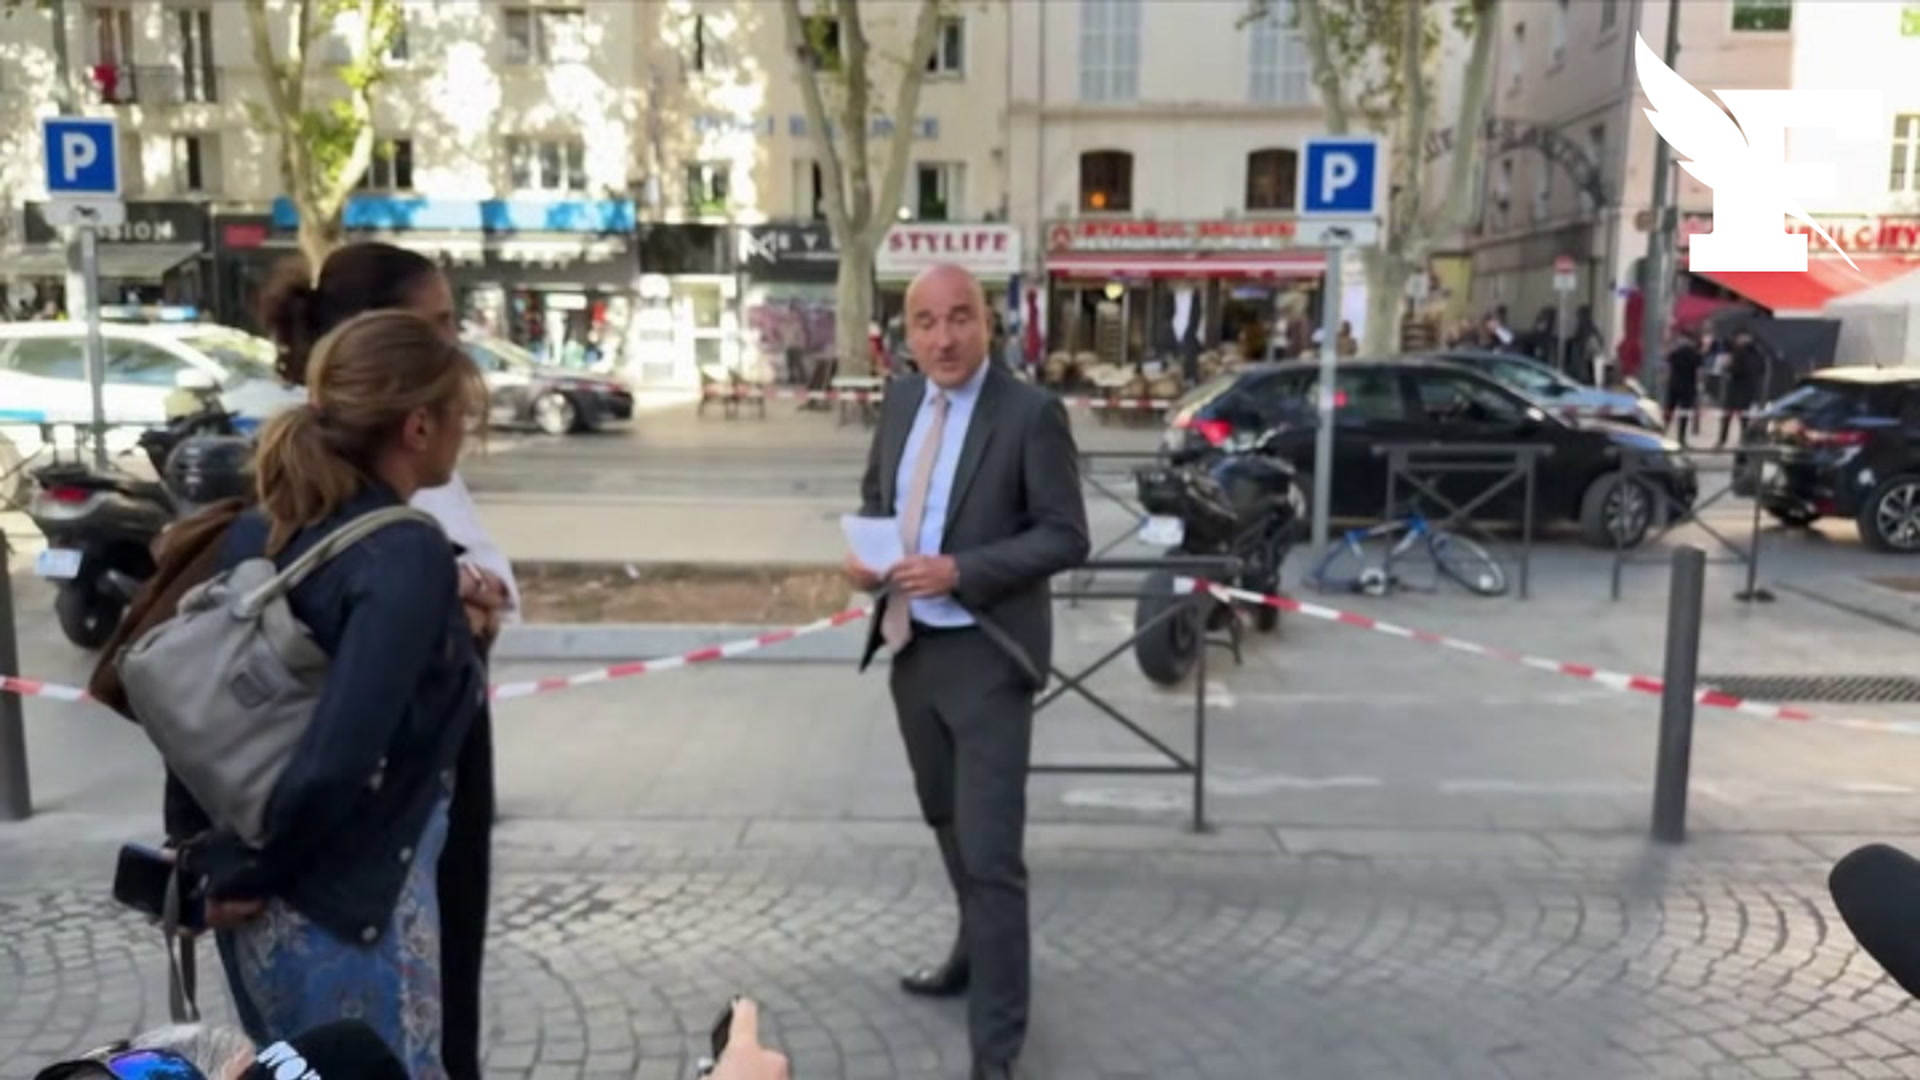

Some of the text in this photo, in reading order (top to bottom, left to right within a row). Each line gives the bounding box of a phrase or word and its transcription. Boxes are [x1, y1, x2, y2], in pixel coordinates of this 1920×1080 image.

[62, 132, 98, 181] P
[1320, 152, 1358, 203] P
[888, 231, 1010, 253] STYLIFE
